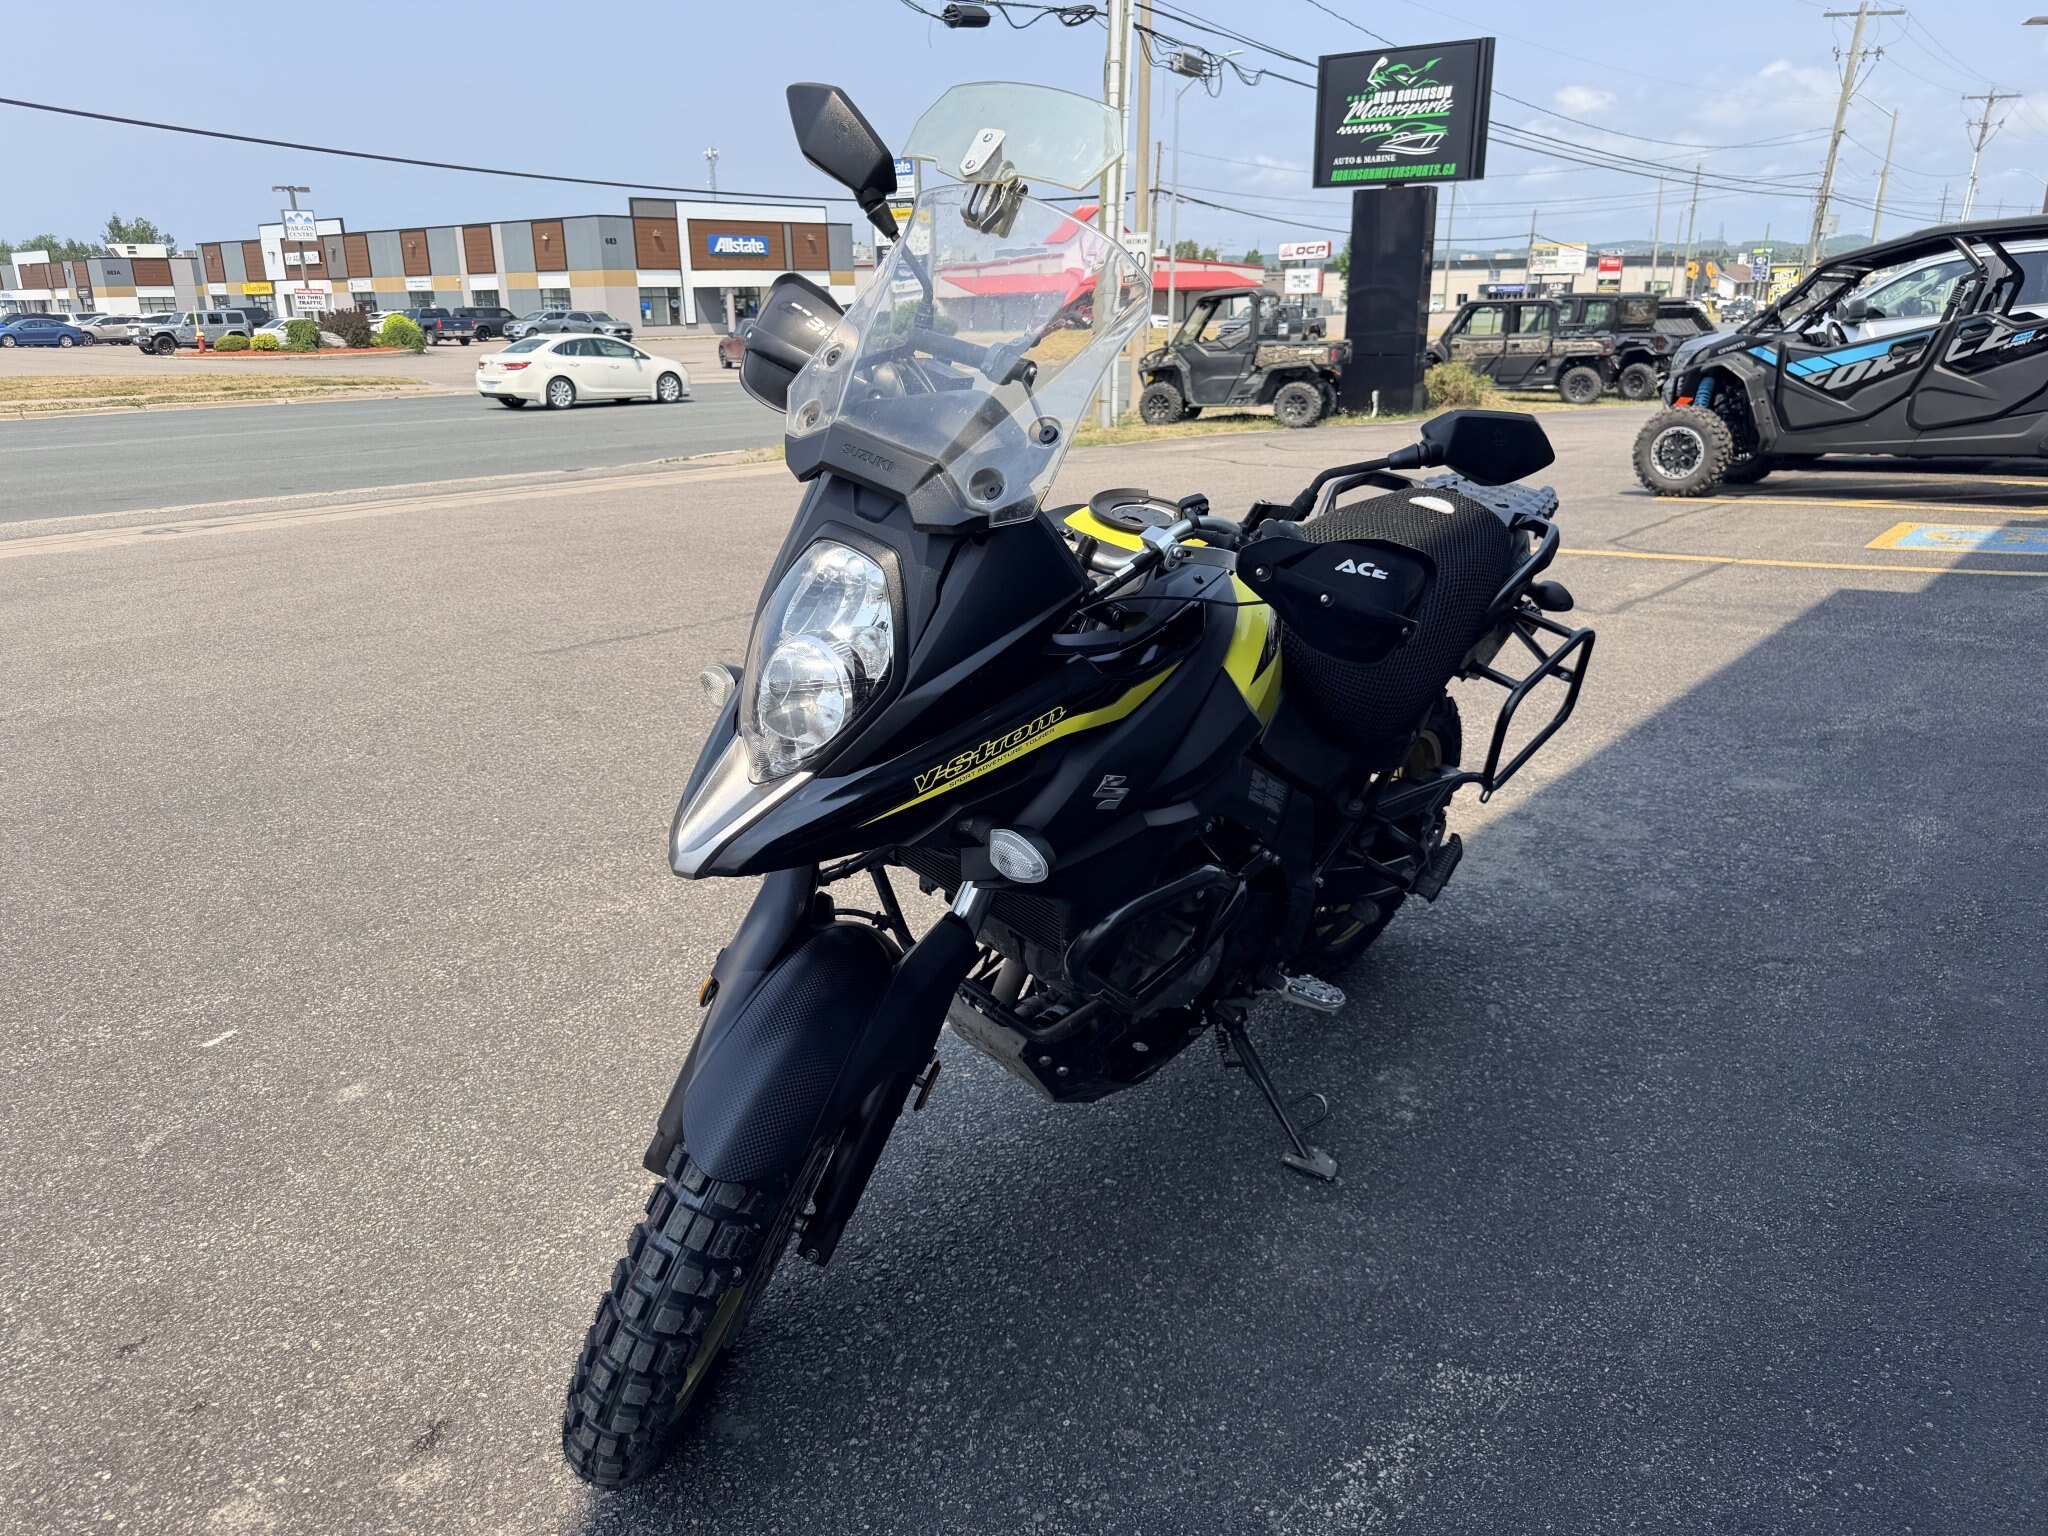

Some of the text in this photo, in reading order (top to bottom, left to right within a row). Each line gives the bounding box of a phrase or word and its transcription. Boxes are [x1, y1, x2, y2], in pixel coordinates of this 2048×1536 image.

[1373, 85, 1454, 104] BUD ROBINSON
[1342, 97, 1454, 124] Motorsports
[1333, 154, 1397, 166] AUTO & MARINE
[1330, 163, 1457, 181] ROBINSONMOTORSPORTS.CA
[714, 237, 766, 253] Allstate
[1296, 245, 1326, 255] OCP
[840, 443, 895, 472] SUZUKI
[914, 706, 1067, 793] V-Strom
[948, 727, 1055, 788] SPORT ADVENTURE TOURER
